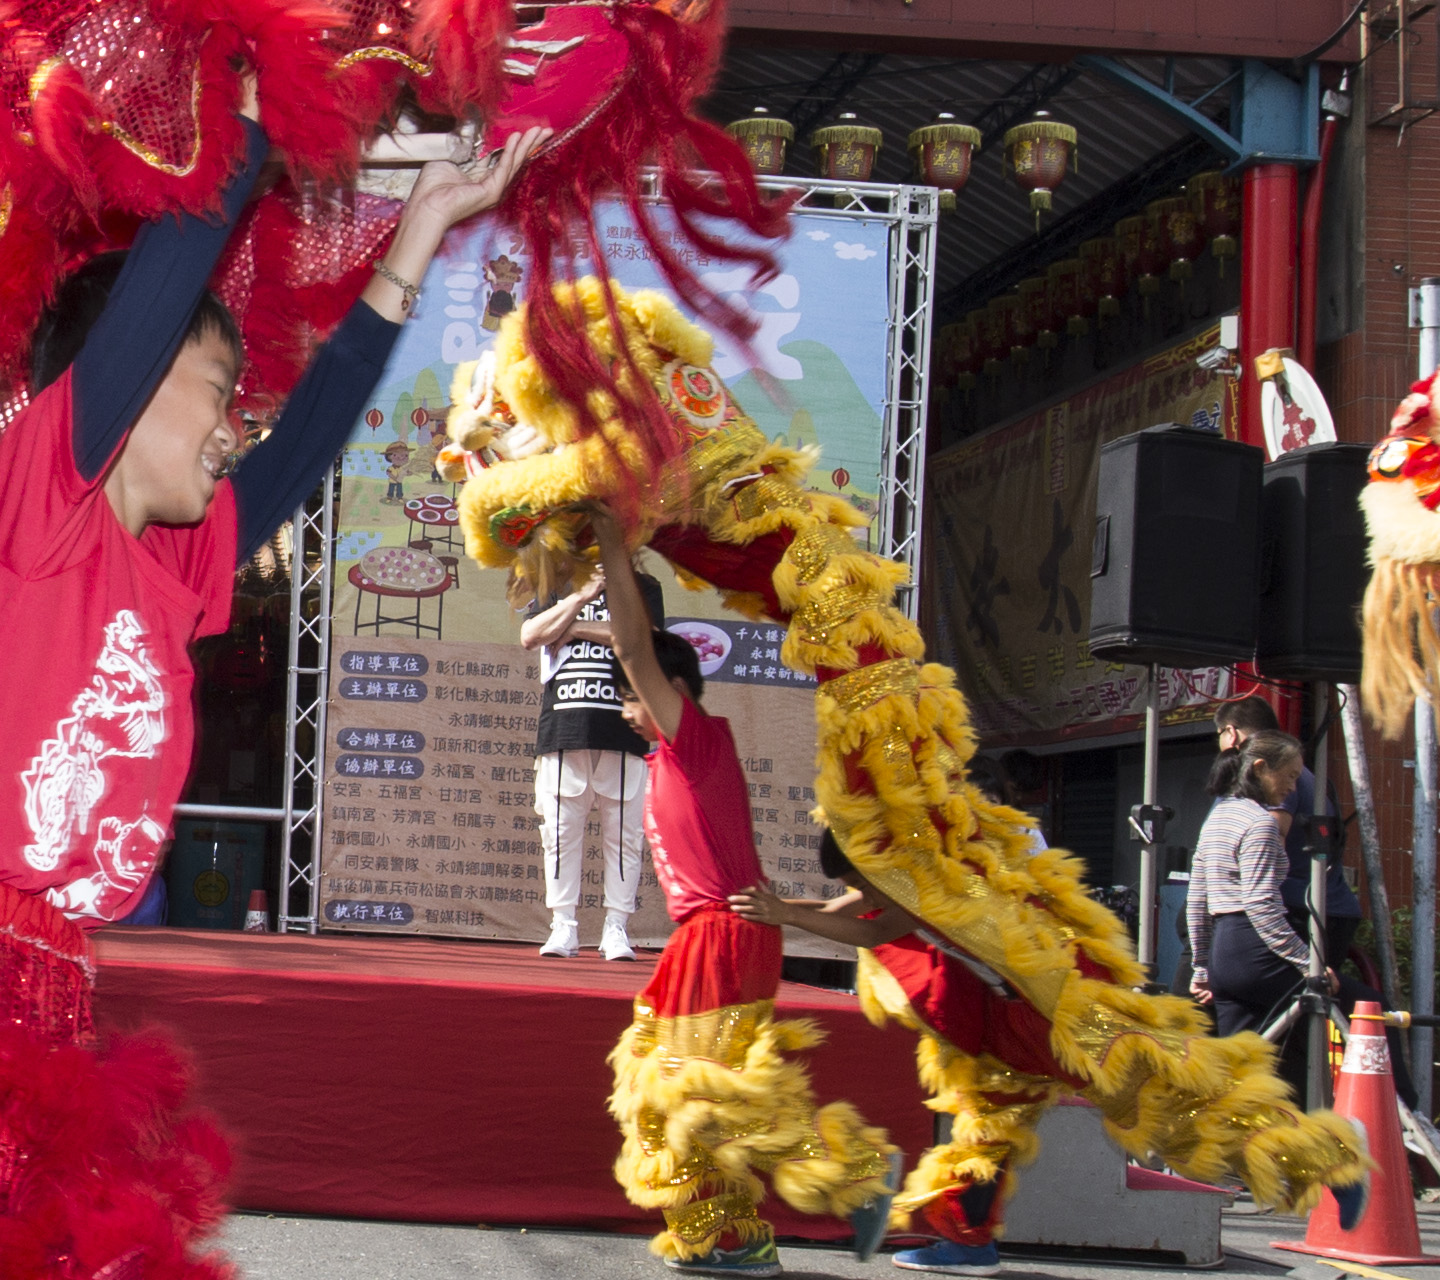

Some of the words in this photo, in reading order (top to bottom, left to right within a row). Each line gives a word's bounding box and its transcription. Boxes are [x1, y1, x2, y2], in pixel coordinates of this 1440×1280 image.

[349, 654, 420, 672] 指導單位
[347, 677, 419, 699] 主辦單位
[345, 729, 417, 750] 合辦單位
[344, 757, 416, 776] 協辦單位
[332, 903, 405, 921] 執行單位
[424, 908, 485, 926] 智媒科技
